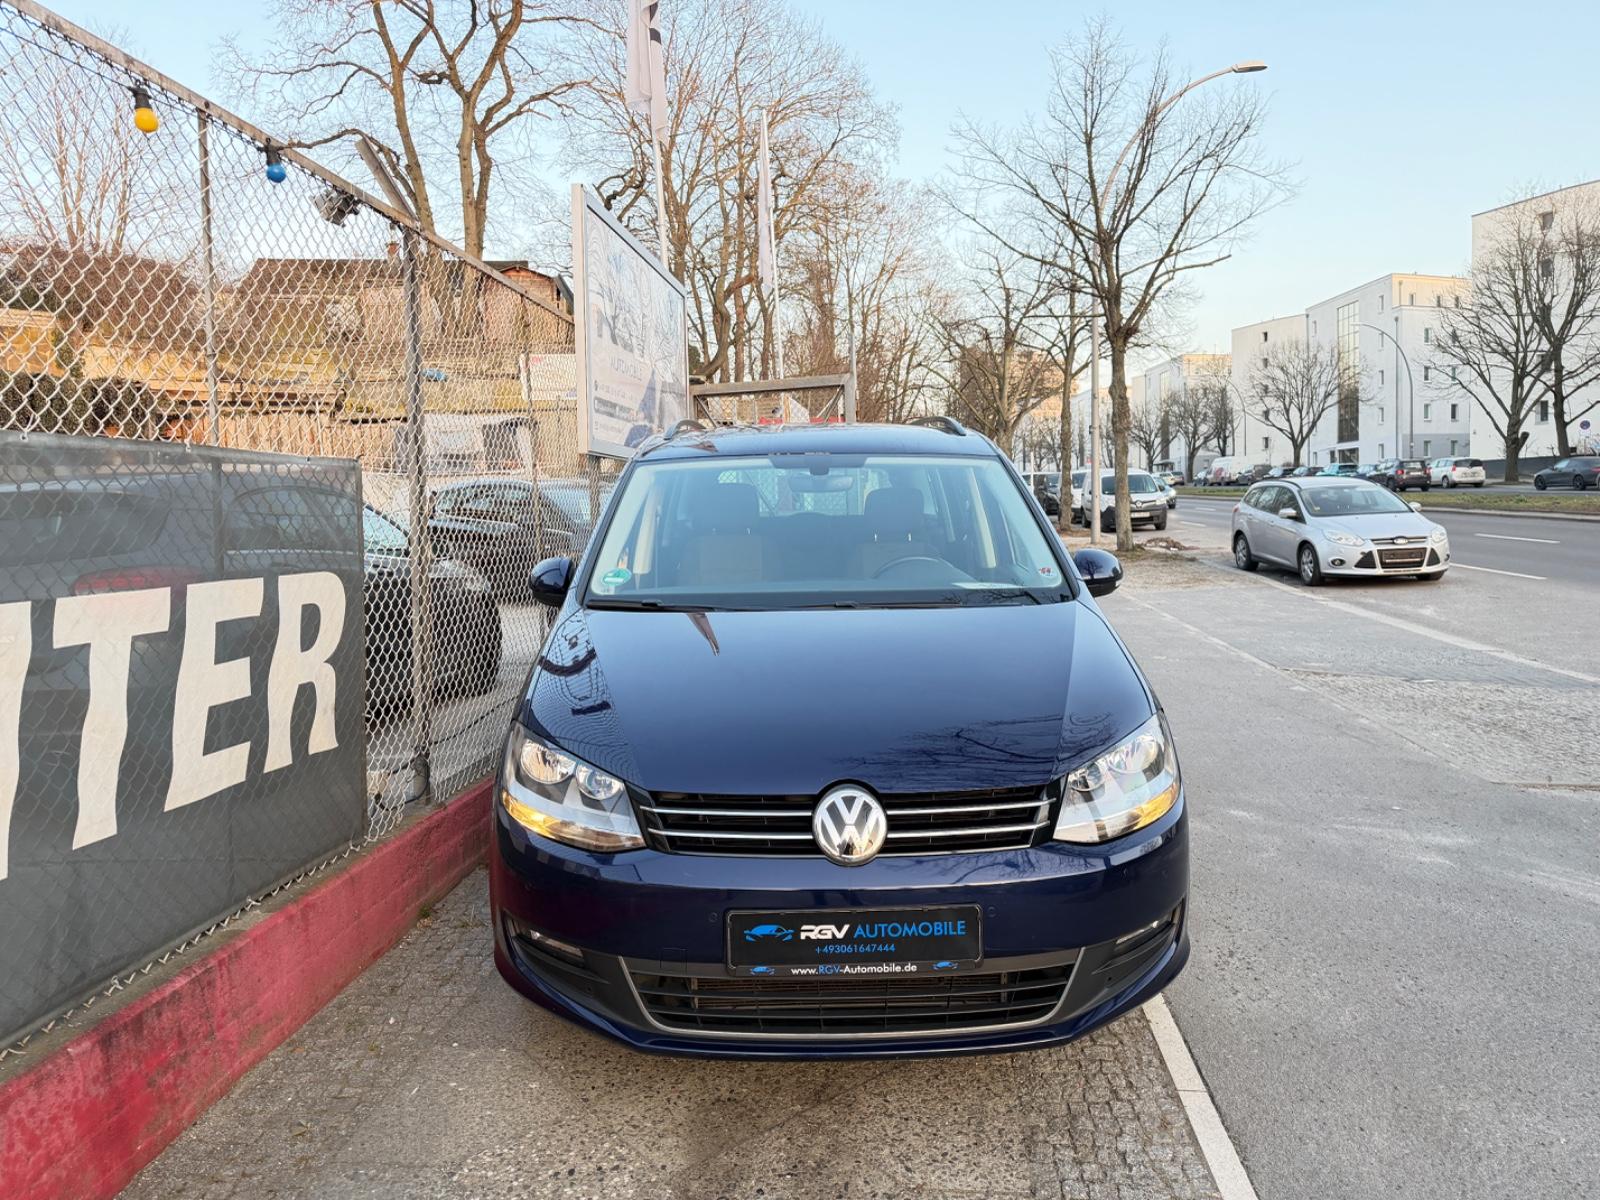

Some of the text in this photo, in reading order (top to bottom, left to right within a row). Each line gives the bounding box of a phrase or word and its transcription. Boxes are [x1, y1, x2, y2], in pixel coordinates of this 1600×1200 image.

[800, 920, 967, 940] RGV AUTOMOBILE
[815, 943, 896, 955] +493061647444
[790, 962, 918, 976] www.RGV-Automobile.de
